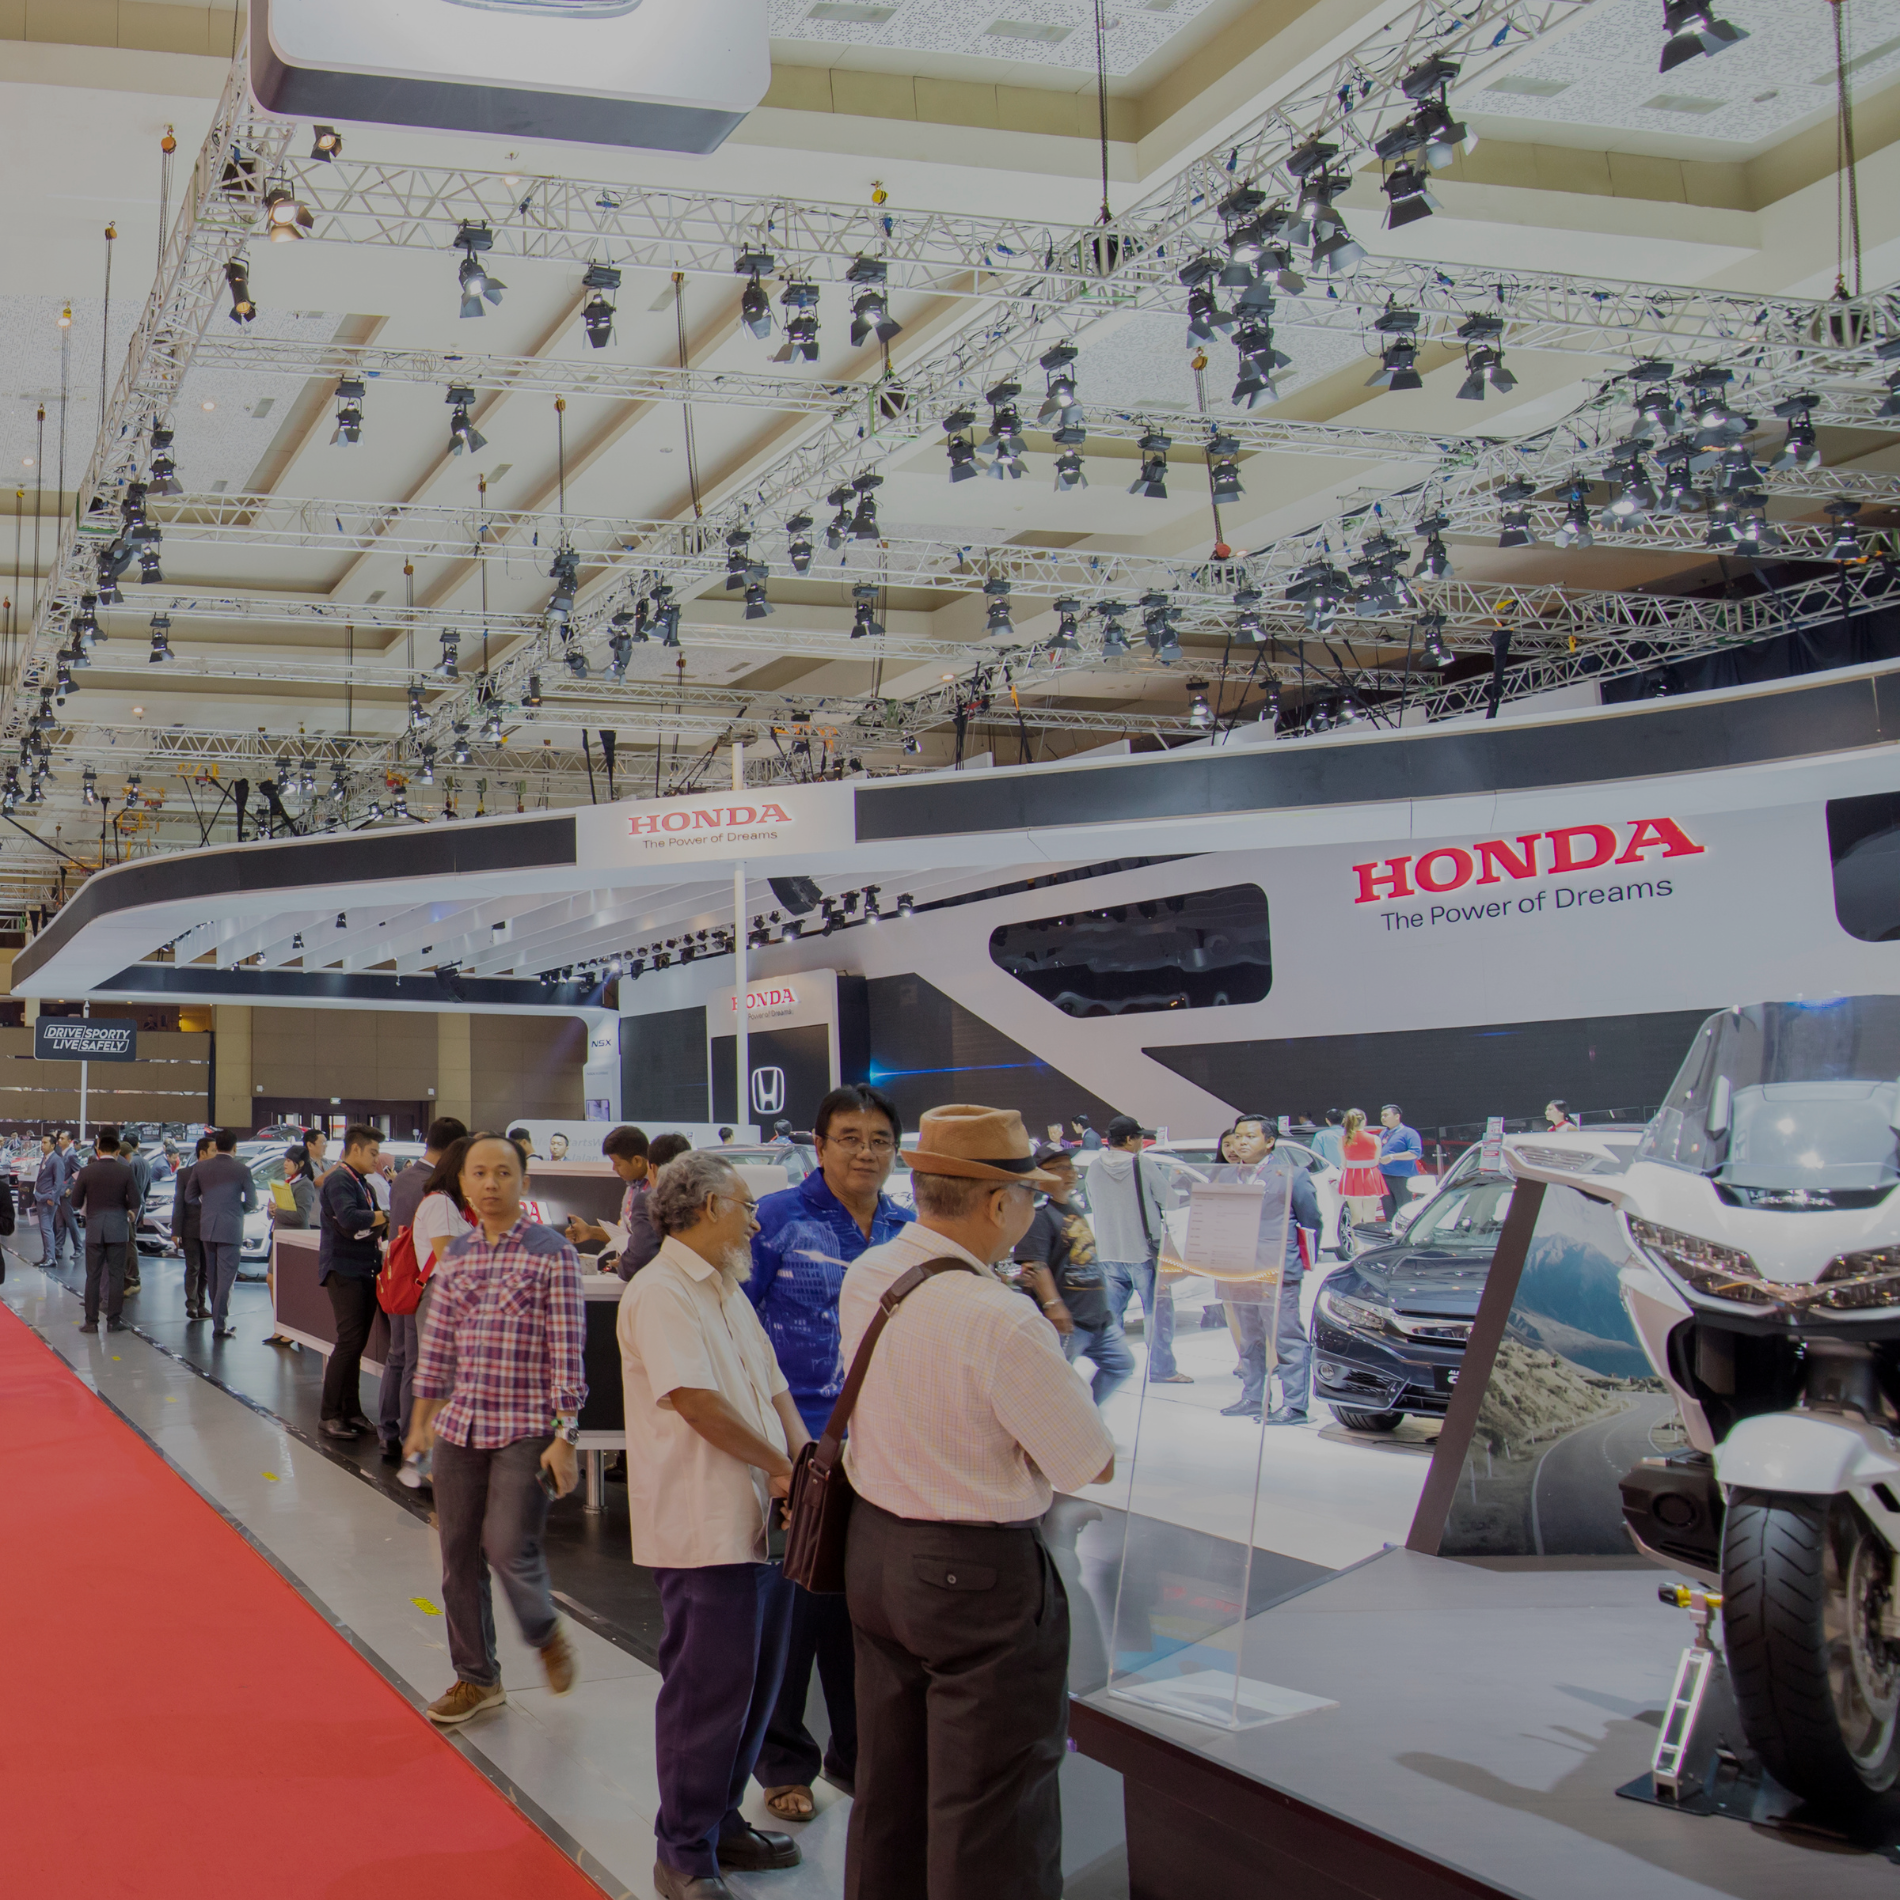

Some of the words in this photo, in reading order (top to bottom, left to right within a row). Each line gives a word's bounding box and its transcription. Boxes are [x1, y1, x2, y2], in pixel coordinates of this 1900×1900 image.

[628, 803, 792, 835] HONDA
[643, 839, 665, 849] The
[669, 835, 708, 847] Power
[711, 833, 723, 843] of
[727, 831, 778, 842] Dreams
[1352, 816, 1706, 904] HONDA
[1381, 912, 1424, 931] The
[1431, 898, 1512, 926] Power
[1518, 891, 1546, 914] of
[1555, 880, 1674, 909] Dreams
[47, 1027, 83, 1037] DRIVE
[85, 1028, 131, 1039] SPORTY
[53, 1039, 79, 1050] LIVE
[81, 1040, 124, 1051] SAFELY
[591, 1039, 612, 1048] NSX
